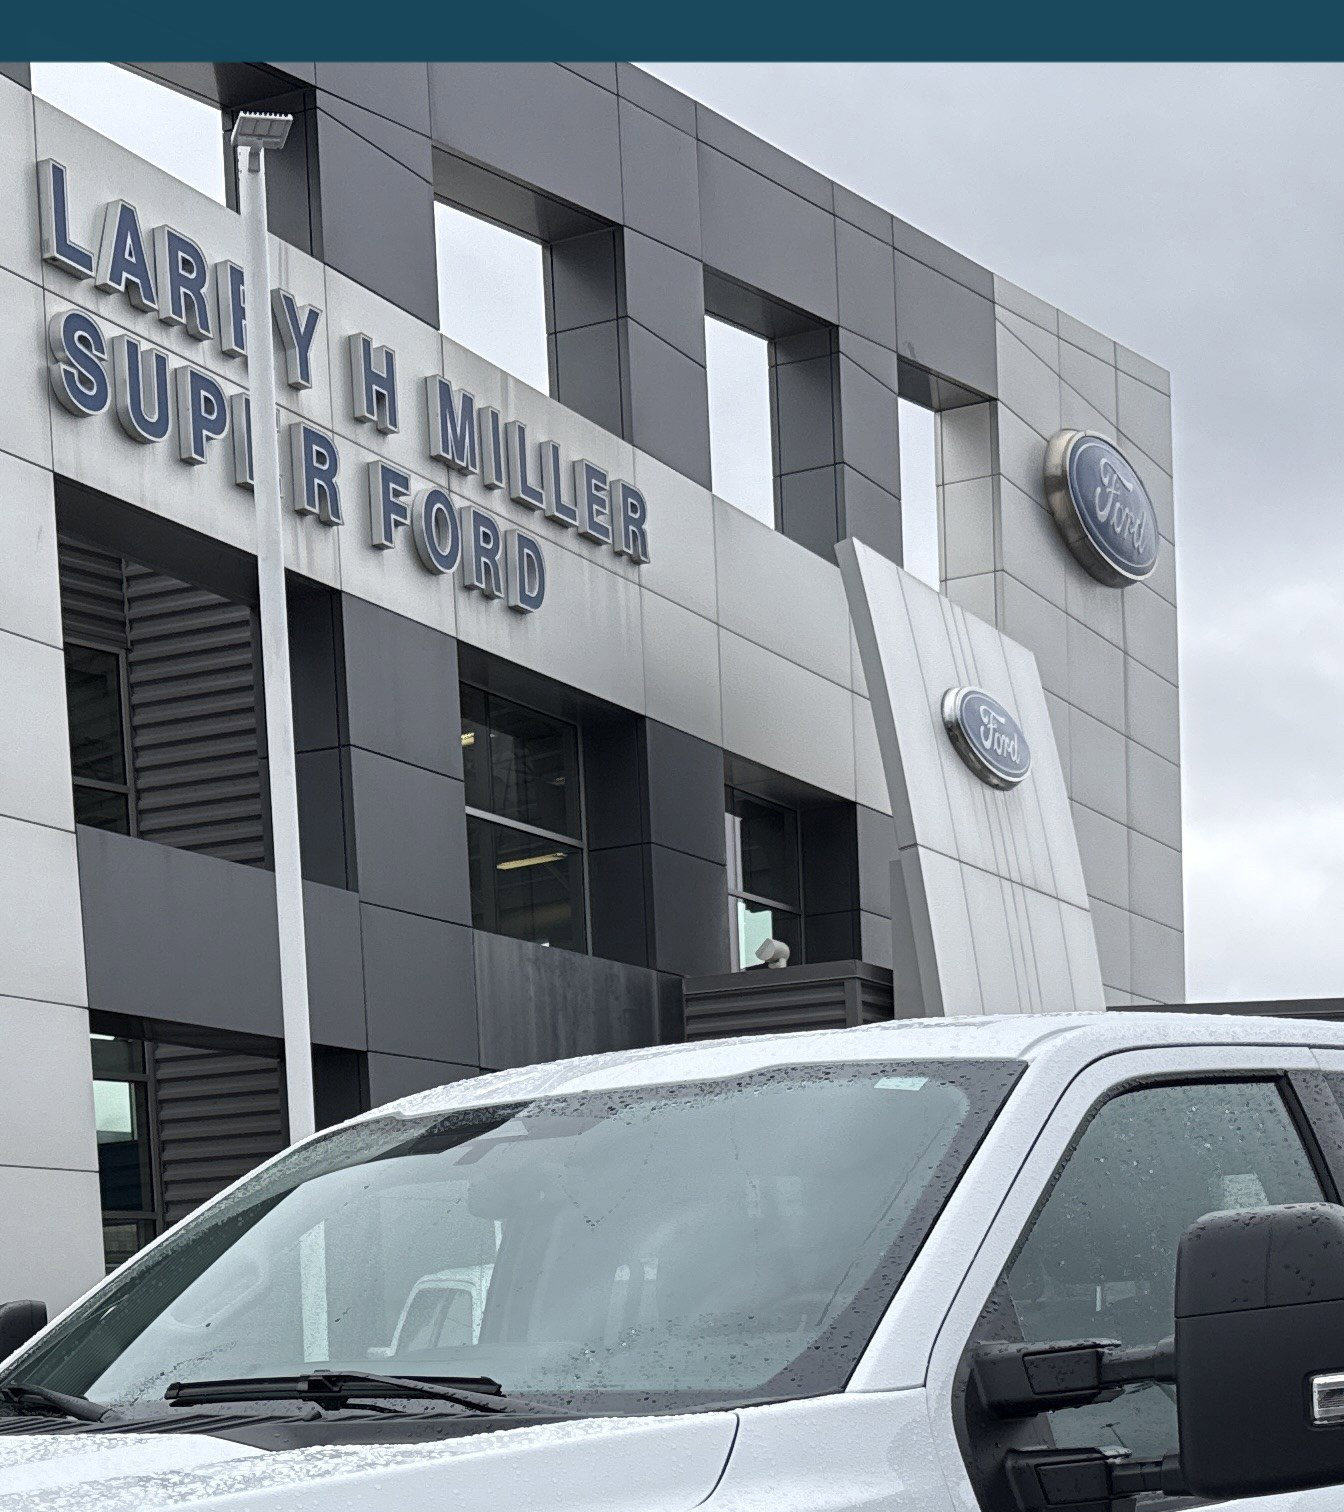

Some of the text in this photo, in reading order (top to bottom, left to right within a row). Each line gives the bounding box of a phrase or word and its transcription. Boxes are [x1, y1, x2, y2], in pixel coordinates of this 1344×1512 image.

[49, 310, 546, 614] SUPR FORD
[349, 332, 399, 435] H
[426, 374, 651, 564] MILLER
[1094, 458, 1148, 553] Ford
[979, 705, 1020, 764] Ford
